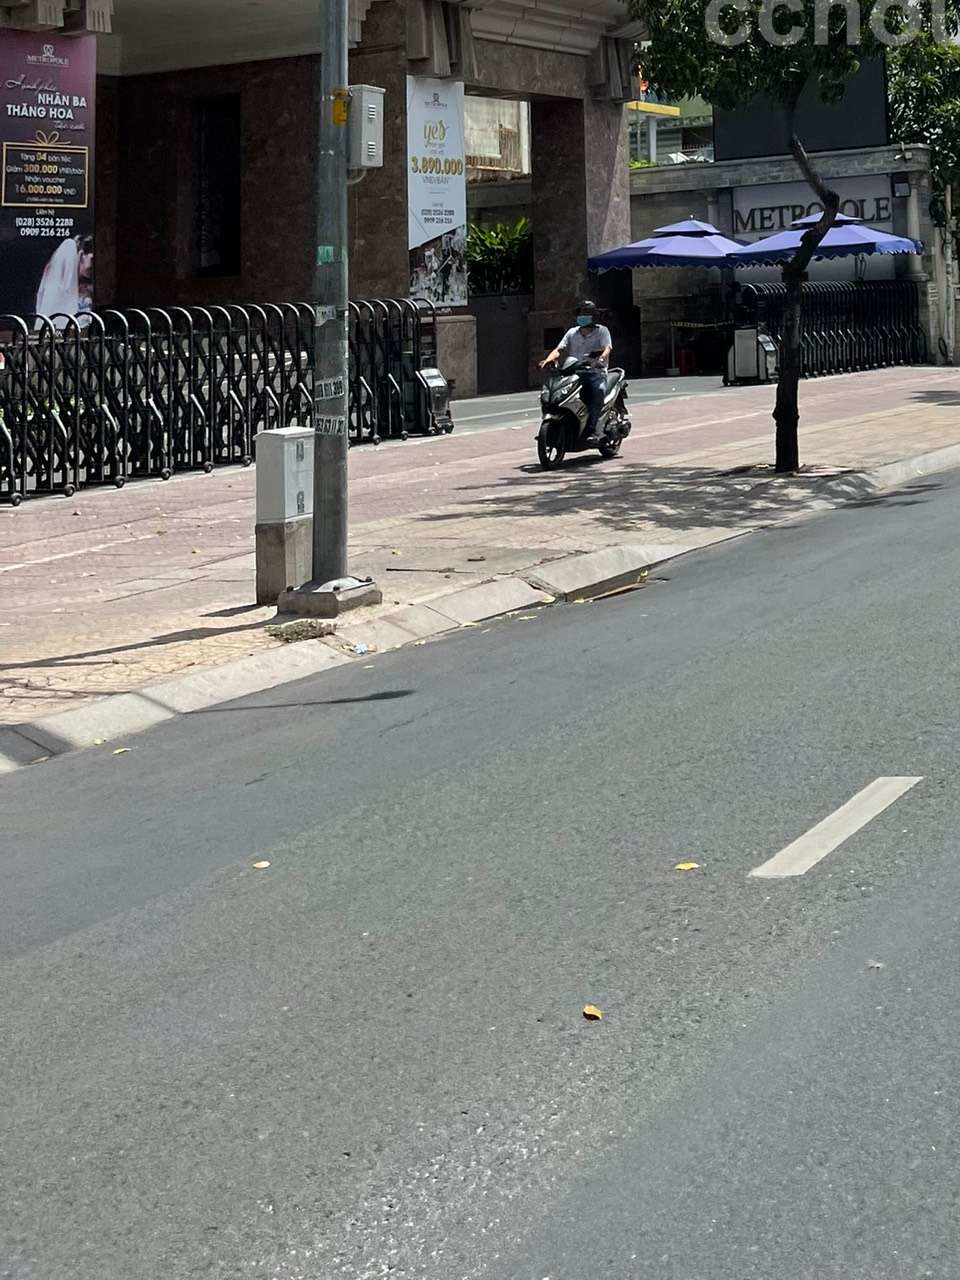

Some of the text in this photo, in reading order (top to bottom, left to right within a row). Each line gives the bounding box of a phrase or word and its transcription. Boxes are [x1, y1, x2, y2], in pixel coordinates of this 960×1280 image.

[72, 95, 87, 108] BA
[6, 102, 74, 120] THĂNG HOA
[23, 163, 58, 174] 300.000
[733, 197, 893, 232] METROOLE
[15, 217, 35, 227] (028)
[35, 217, 55, 226] 3526
[20, 227, 70, 236] 0909 216 216
